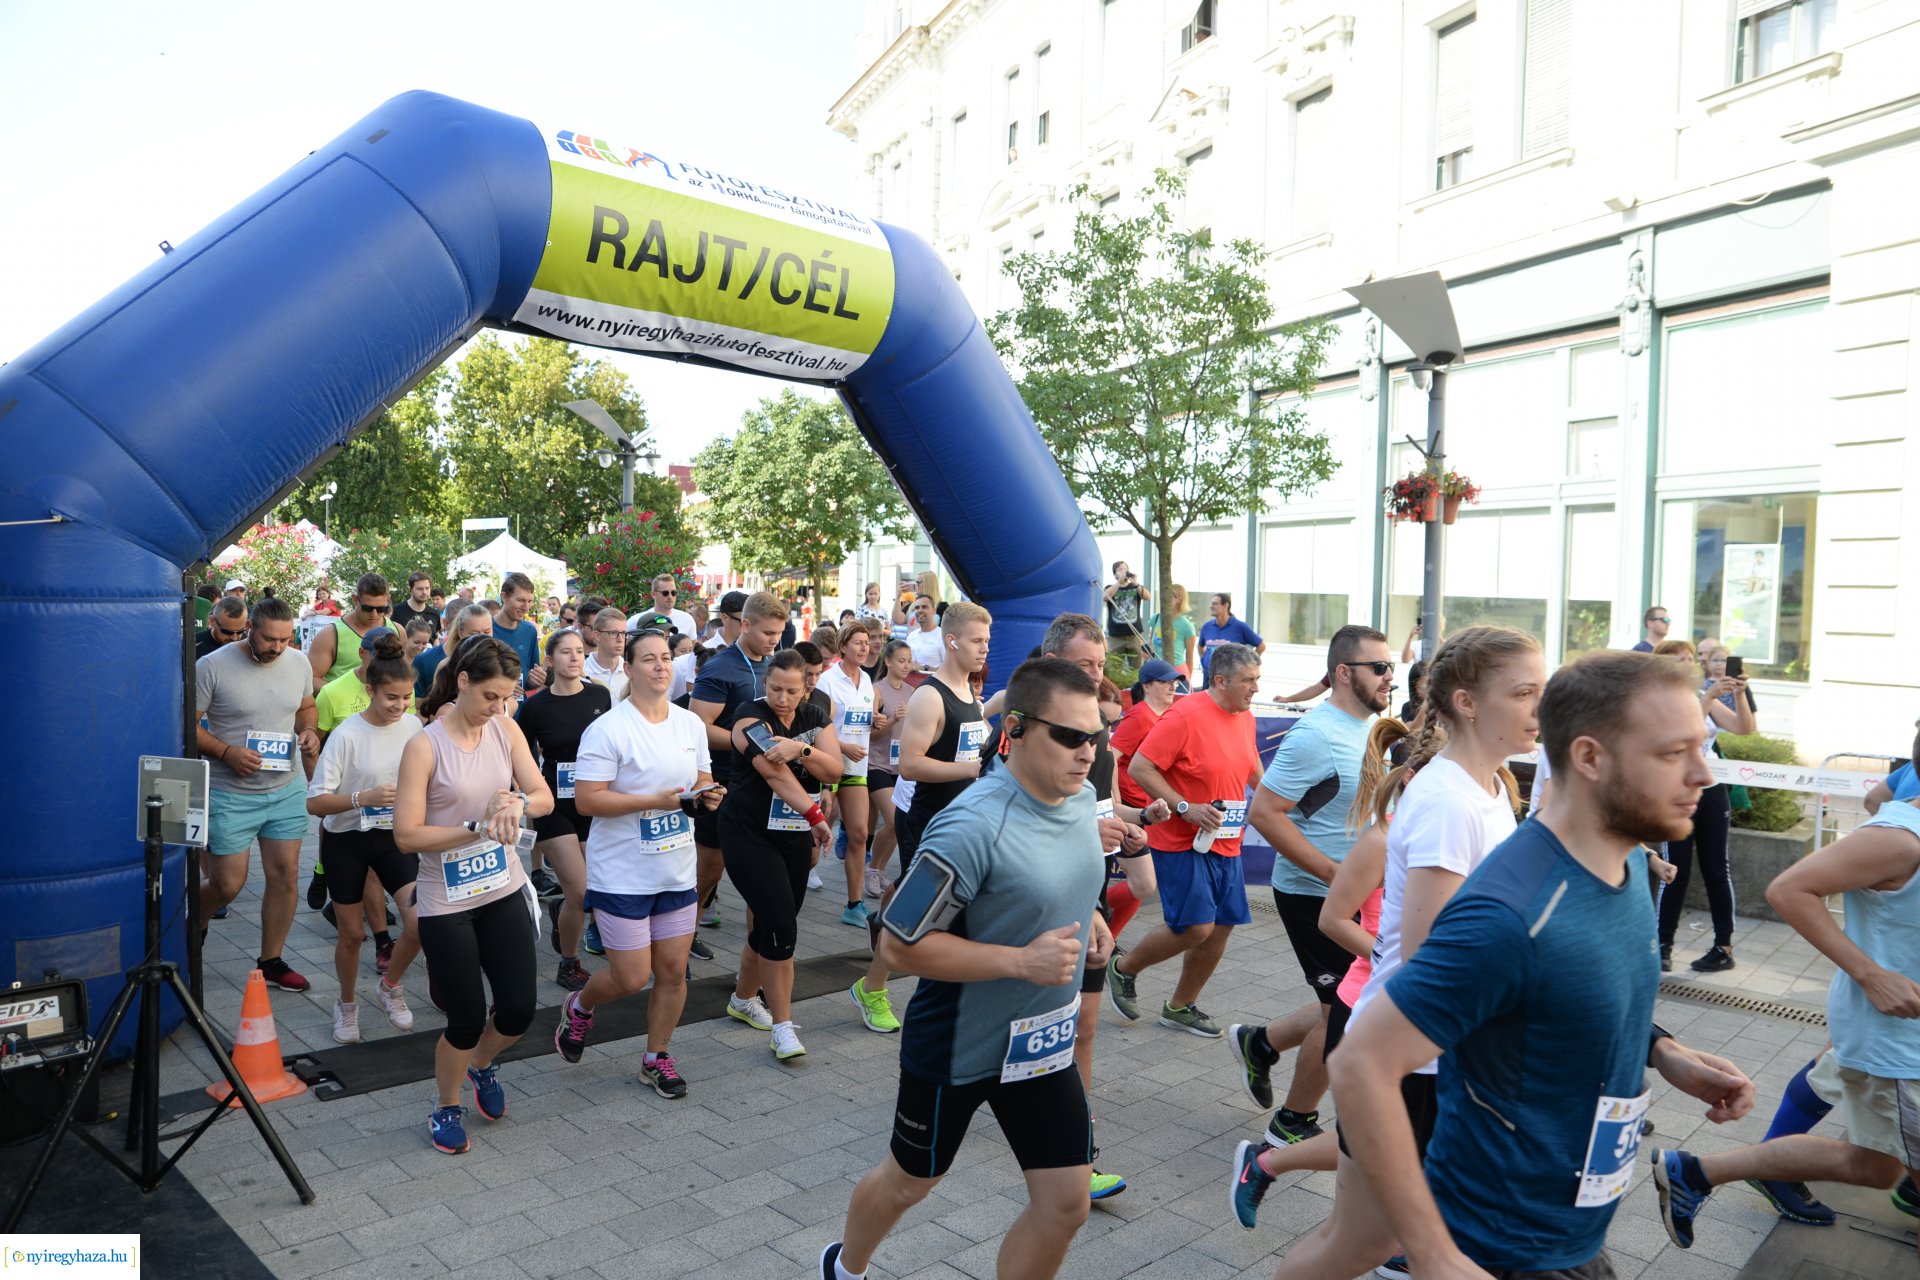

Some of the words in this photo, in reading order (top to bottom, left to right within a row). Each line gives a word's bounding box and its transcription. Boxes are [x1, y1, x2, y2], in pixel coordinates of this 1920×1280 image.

[688, 178, 703, 188] az
[586, 205, 860, 320] RAJT/CÉL
[537, 302, 848, 373] www.nyiregyhazifutofesztival.hu
[850, 712, 869, 722] 571
[257, 740, 289, 755] 640
[191, 824, 200, 840] 7
[650, 813, 681, 835] 519
[457, 852, 498, 878] 508
[1026, 1018, 1074, 1054] 639
